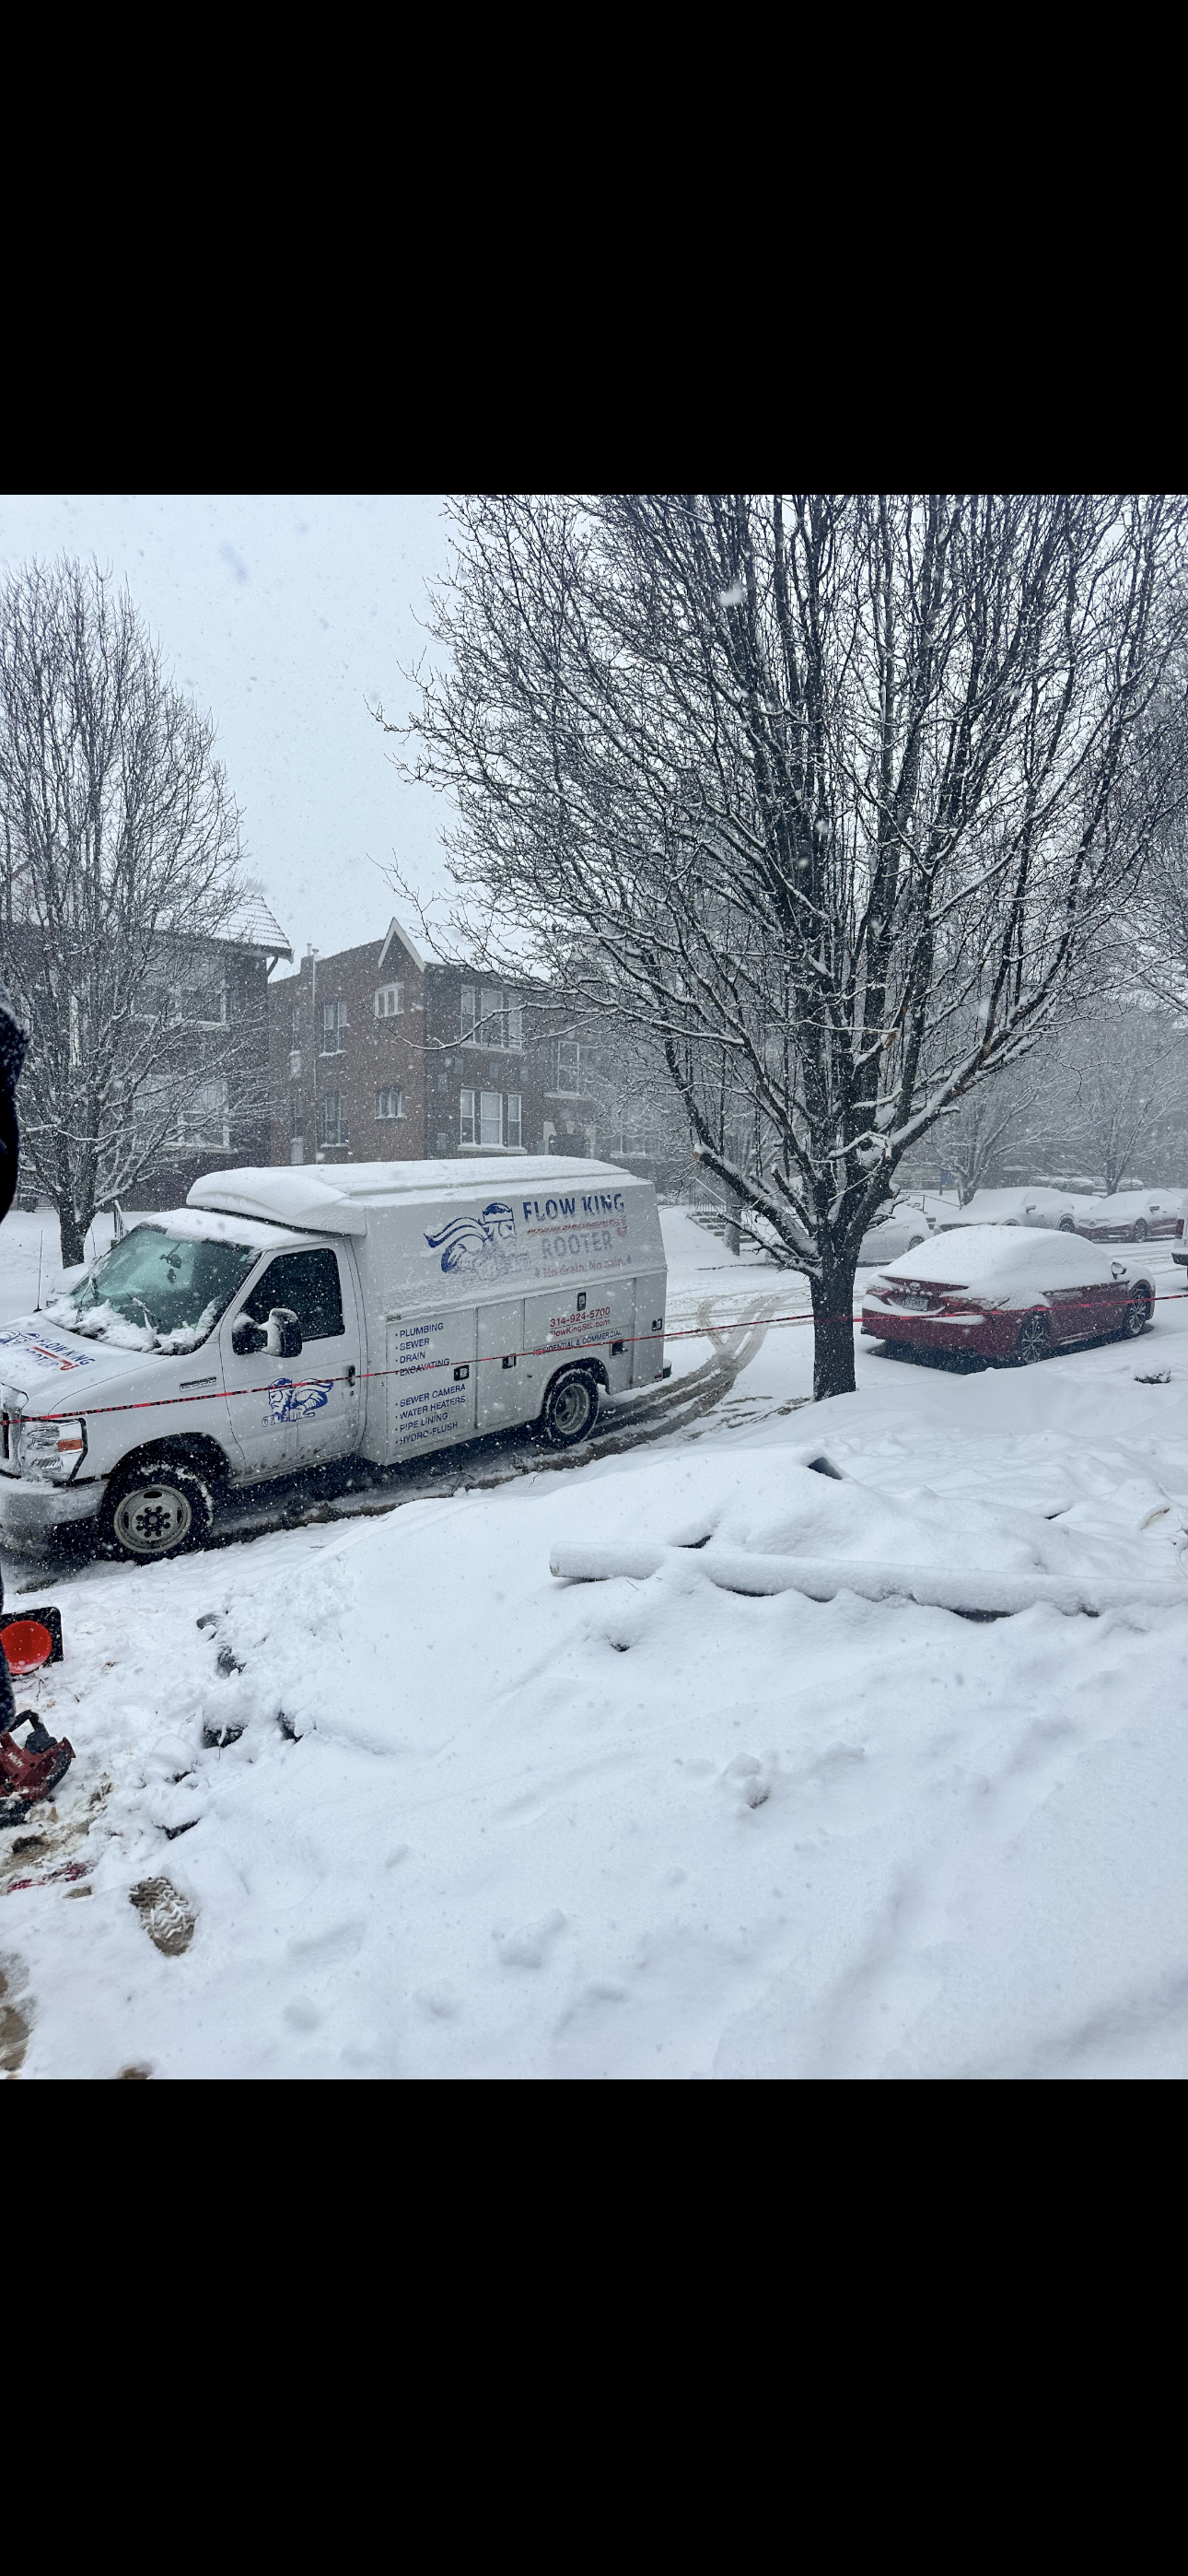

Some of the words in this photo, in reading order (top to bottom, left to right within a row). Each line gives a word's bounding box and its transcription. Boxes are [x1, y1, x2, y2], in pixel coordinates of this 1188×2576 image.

[522, 1197, 576, 1224] FLOW
[581, 1193, 624, 1216] KING
[542, 1230, 613, 1259] ROOTER
[550, 1306, 611, 1328] 314-924-5700
[400, 1322, 444, 1338] PLUMBING
[582, 1329, 623, 1344] COMMERCIAL
[400, 1338, 430, 1351] SEWER
[62, 1350, 96, 1365] KING
[400, 1352, 426, 1364] DRAIN
[400, 1358, 450, 1376] EXCAVATING
[400, 1392, 430, 1407] SEWER
[432, 1384, 466, 1399] CAMERA
[400, 1405, 428, 1420] WATER
[430, 1395, 466, 1411] HEATERS
[400, 1420, 419, 1432] PIPE
[421, 1412, 448, 1426] LINING
[400, 1422, 459, 1445] HYDRO-FLUSH
